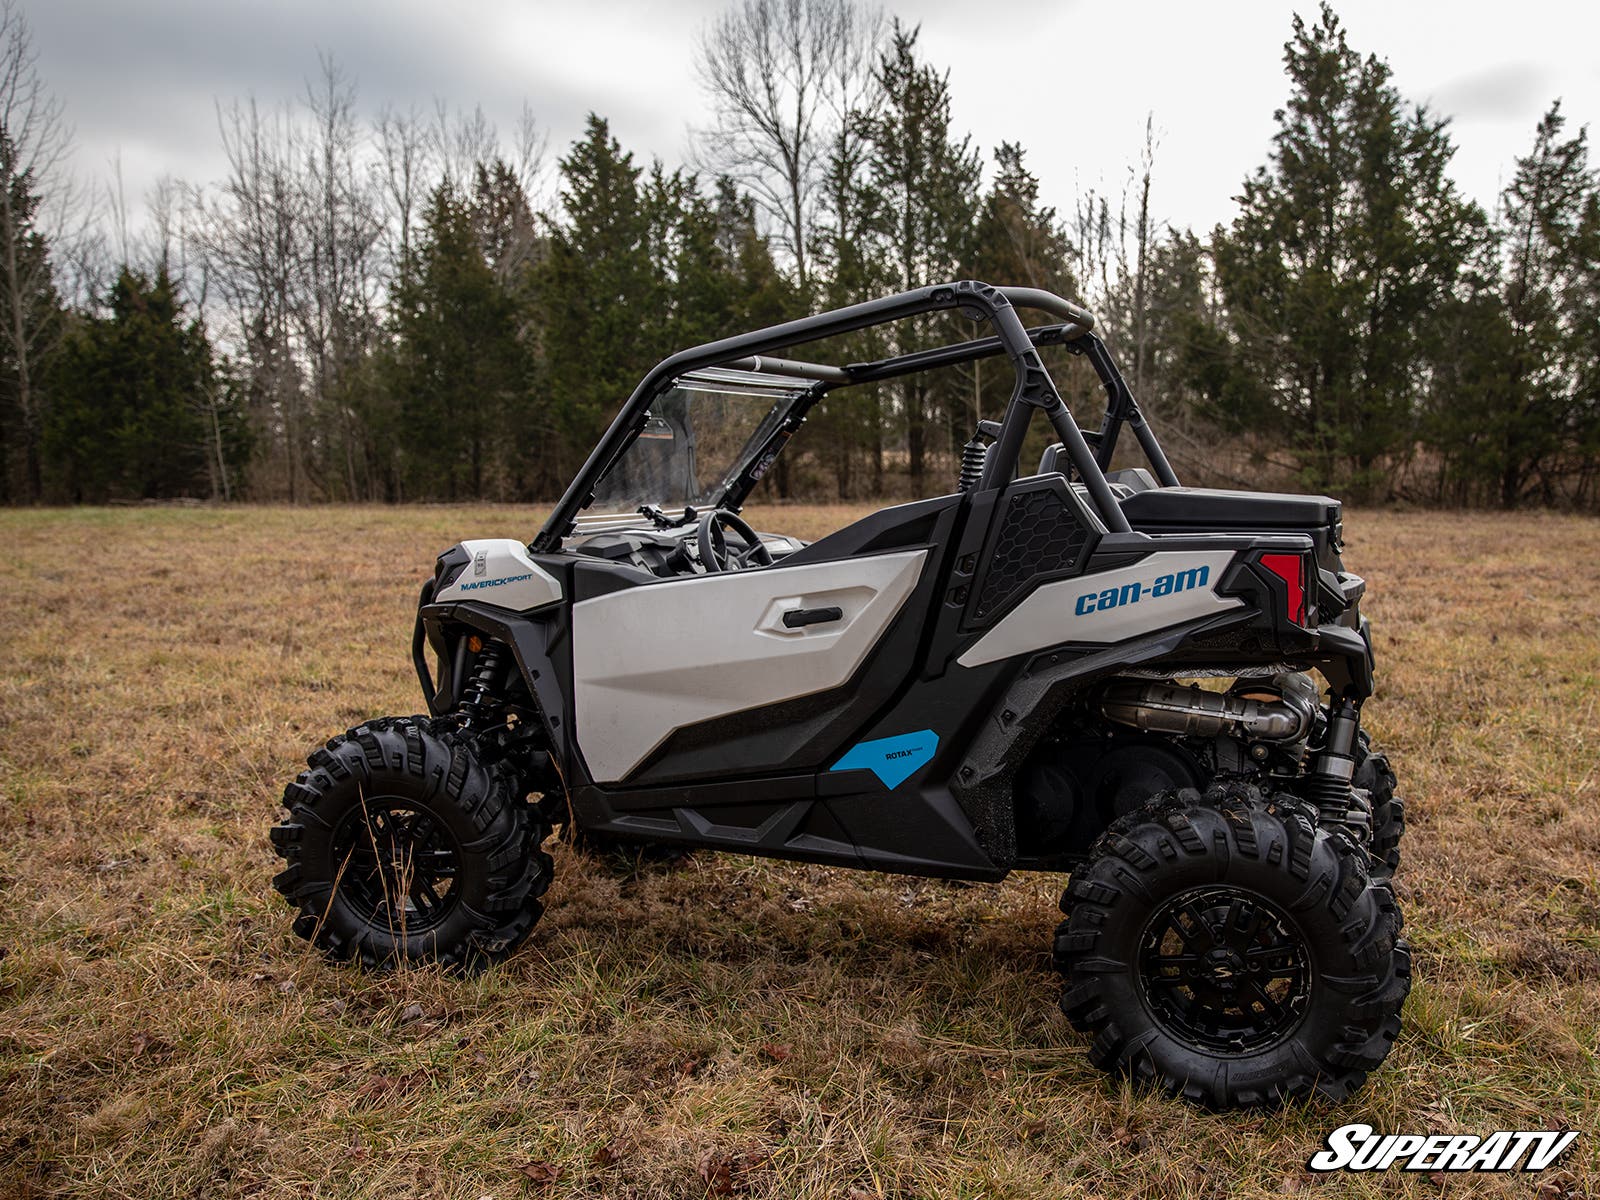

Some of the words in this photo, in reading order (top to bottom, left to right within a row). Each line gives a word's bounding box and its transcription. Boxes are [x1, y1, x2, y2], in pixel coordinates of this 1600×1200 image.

[461, 579, 507, 591] MAVERICK
[507, 574, 533, 583] SPORT
[1075, 565, 1210, 616] can-am
[885, 749, 912, 760] ROTAX
